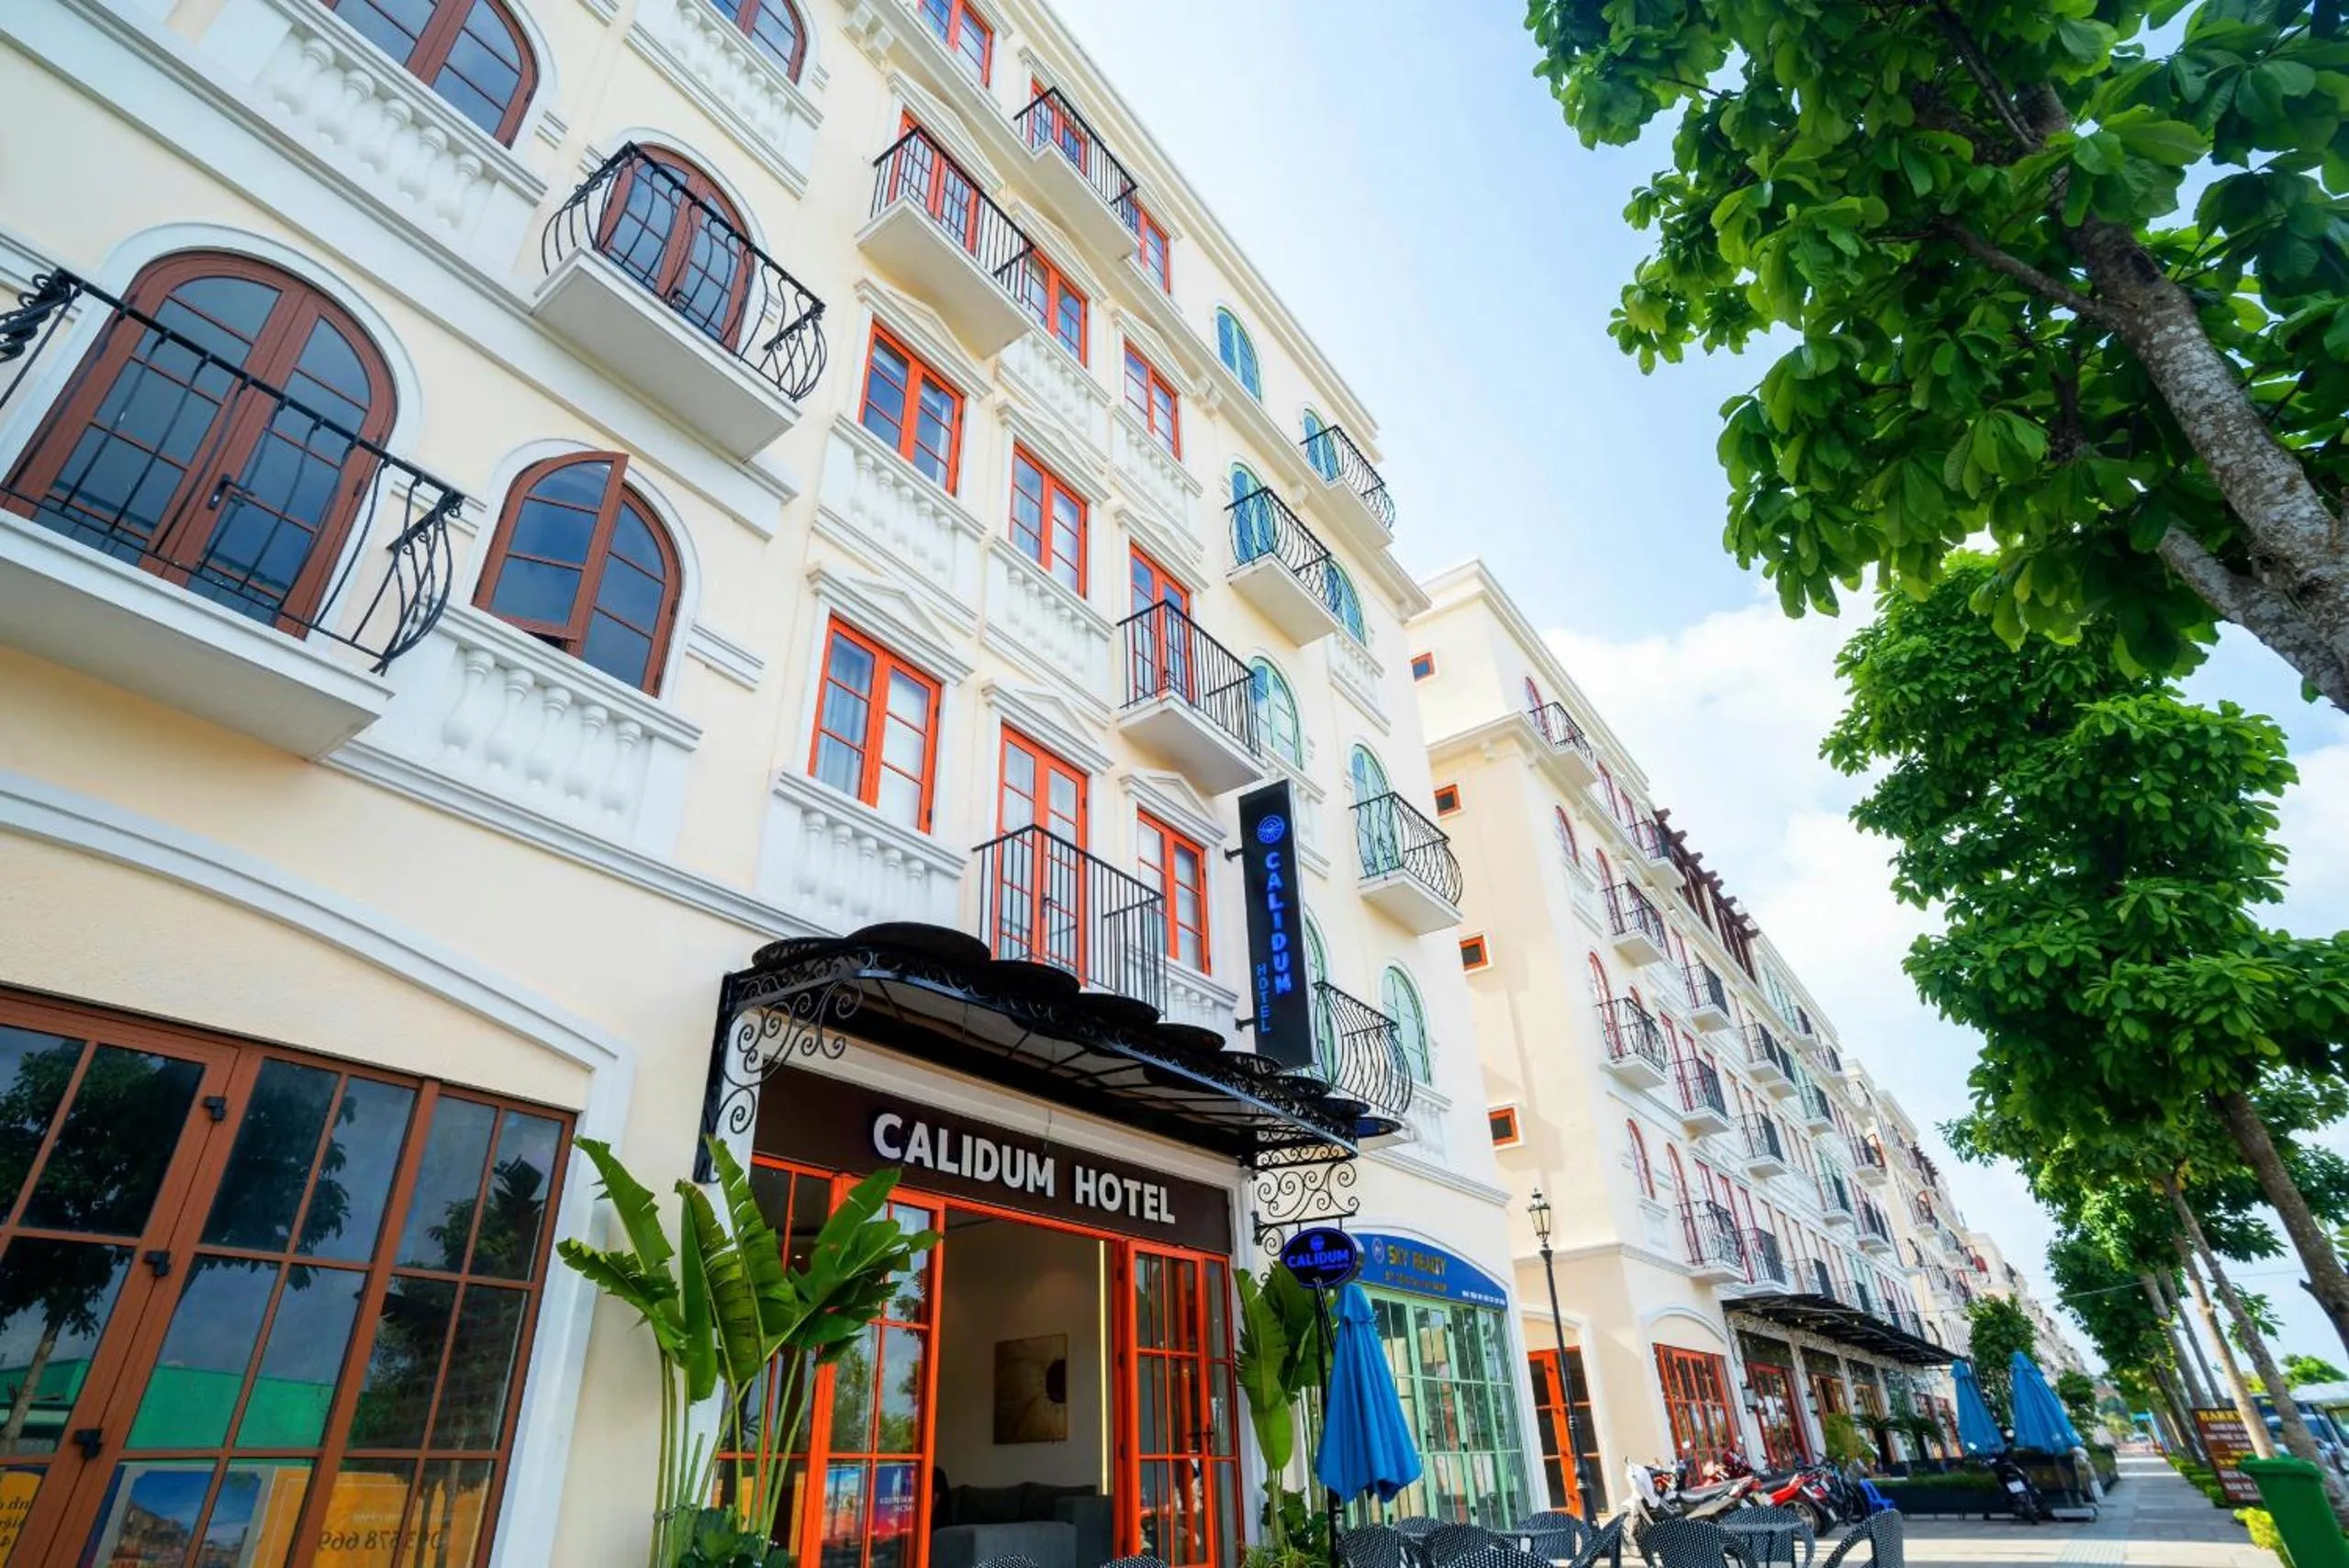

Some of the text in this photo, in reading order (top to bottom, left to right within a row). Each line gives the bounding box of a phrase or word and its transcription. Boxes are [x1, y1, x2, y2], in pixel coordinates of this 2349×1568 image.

[1265, 851, 1292, 994] CALIDUM
[1257, 964, 1271, 1033] HOTEL
[873, 1113, 1176, 1225] CALIDUM HOTEL
[1287, 1249, 1349, 1268] CALIDUM
